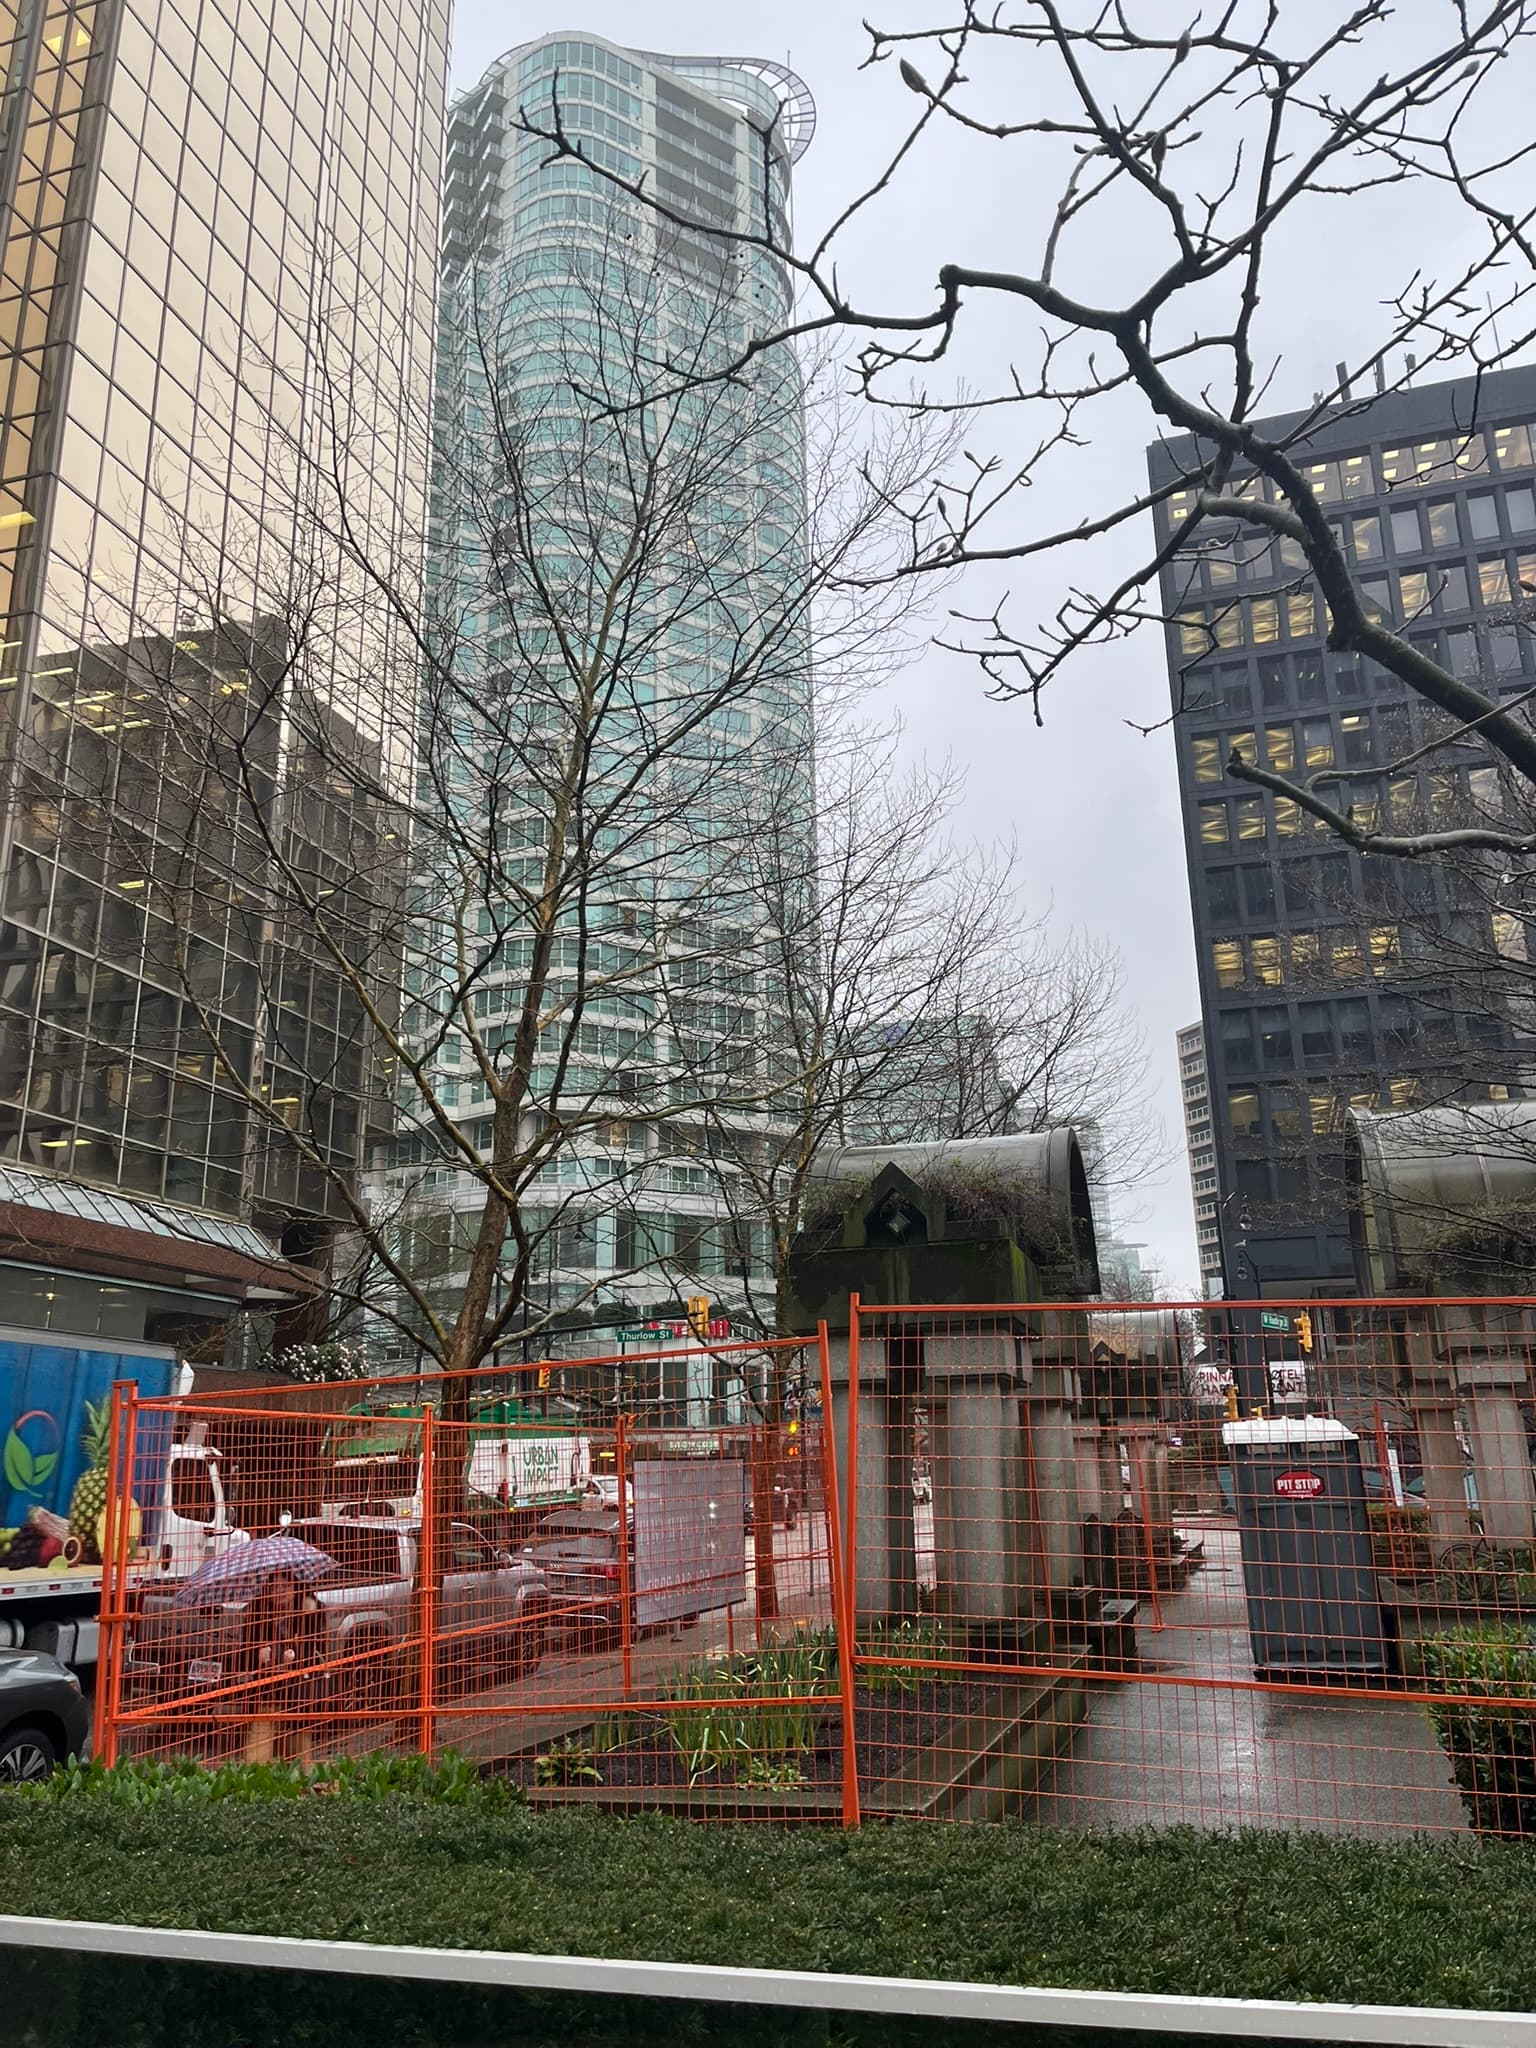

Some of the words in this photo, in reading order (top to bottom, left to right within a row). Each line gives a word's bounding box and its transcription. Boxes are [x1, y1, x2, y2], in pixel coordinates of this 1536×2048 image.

[622, 1331, 655, 1341] Thurlow
[659, 1330, 670, 1339] St
[523, 1445, 558, 1466] URBAN
[524, 1466, 559, 1486] IMPACT
[1277, 1479, 1293, 1490] PIT
[1294, 1478, 1321, 1490] STOP
